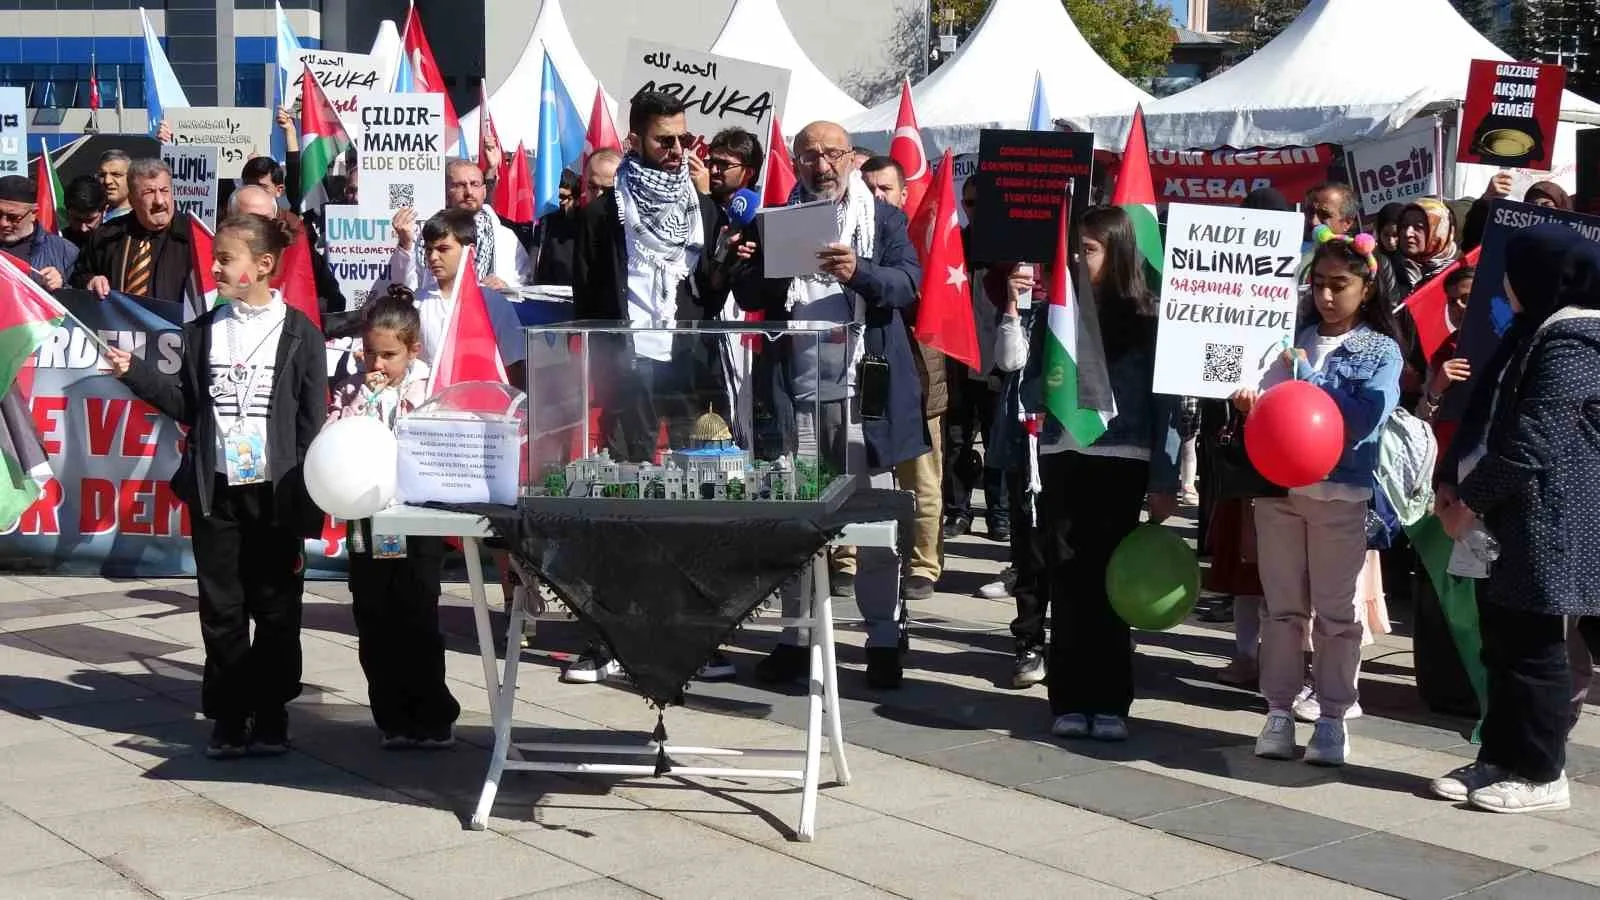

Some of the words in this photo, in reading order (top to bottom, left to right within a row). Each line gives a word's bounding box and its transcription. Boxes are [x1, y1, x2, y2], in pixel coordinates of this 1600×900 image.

[643, 52, 671, 69] لله
[673, 60, 717, 80] الحمد
[293, 70, 379, 90] LUKA
[1496, 64, 1540, 79] GAZZEDE
[1493, 82, 1537, 100] AKŞAM
[362, 106, 440, 131] ÇILDIR-
[1492, 102, 1535, 118] YEMEĞİ
[364, 133, 439, 152] MAMAK
[362, 156, 394, 170] ELDE
[399, 153, 440, 171] DEĞİL!
[328, 218, 390, 241] UMUT
[1188, 223, 1248, 244] KALDI
[1253, 228, 1281, 248] BU
[328, 246, 347, 256] KAÇ
[349, 245, 398, 255] KİLOMETR
[1172, 247, 1295, 278] SİLİNMEZ
[1166, 299, 1293, 330] ÜZERİMİZDE
[33, 326, 146, 371] RDEN
[85, 396, 162, 457] VE
[79, 478, 193, 538] DEM
